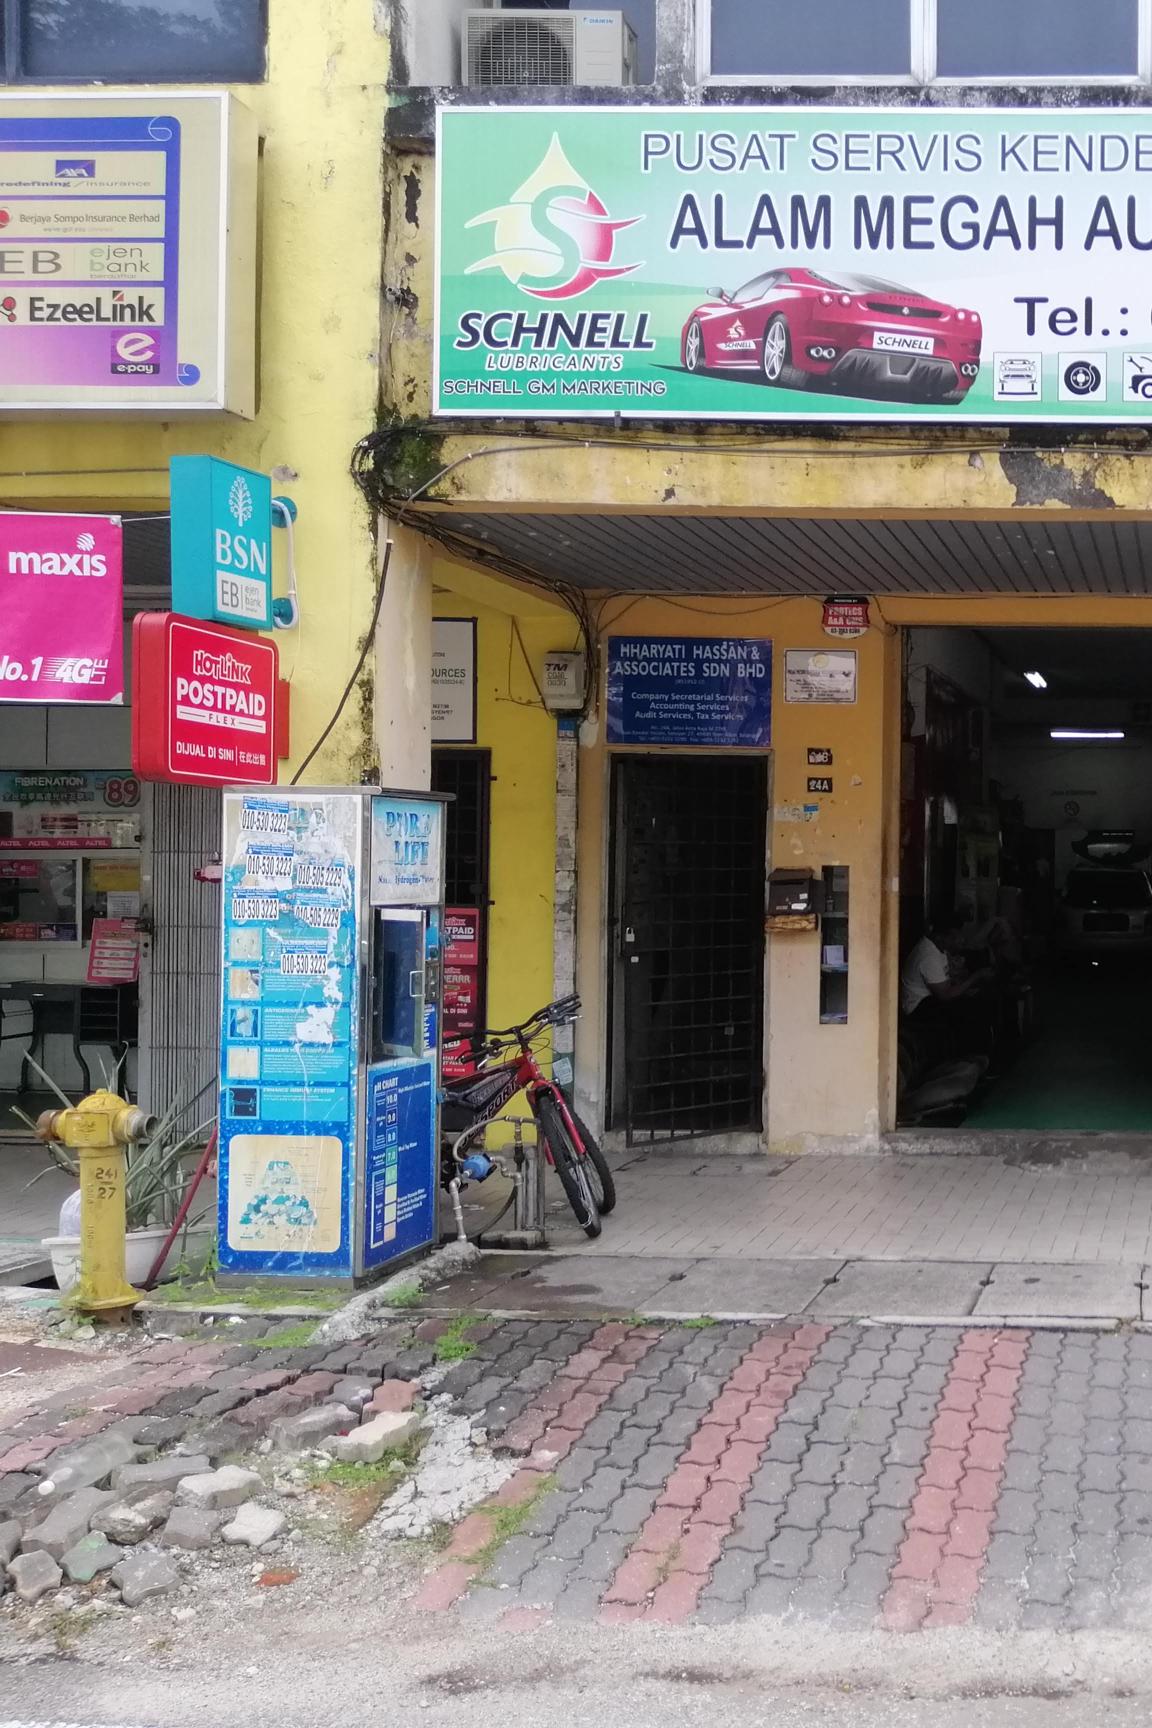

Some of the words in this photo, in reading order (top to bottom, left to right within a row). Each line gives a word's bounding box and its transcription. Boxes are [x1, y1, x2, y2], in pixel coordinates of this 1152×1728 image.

[643, 133, 796, 172] PUSAT
[812, 133, 983, 173] SERVIS
[56, 168, 88, 177] AXA
[20, 213, 52, 225] Berjaya
[54, 213, 84, 224] Sompo
[85, 213, 127, 223] Insurance
[129, 212, 160, 223] Berhad
[669, 193, 832, 251] ALAM
[853, 193, 1065, 252] MEGAH
[90, 245, 143, 260] ejen
[90, 260, 150, 273] bank
[29, 290, 156, 323] EzeeLink
[1013, 296, 1130, 337] Tel.:
[455, 311, 656, 351] SCHNELL
[723, 340, 754, 350] SCHNELL
[877, 335, 931, 351] SCHNELL
[486, 354, 623, 372] LUBRICANTS
[443, 379, 523, 395] SCHNELL
[527, 380, 557, 396] GM
[561, 380, 667, 396] MARKETING
[215, 528, 266, 575] BSN
[9, 550, 107, 577] maxis
[221, 579, 239, 608] EB
[620, 643, 685, 660] HHARYATI
[693, 643, 746, 660] HASSAN
[750, 645, 760, 660] &
[55, 658, 93, 684] 4G
[91, 658, 109, 684] LTE
[545, 663, 568, 671] TM
[613, 660, 695, 677] ASSOCIATES
[702, 662, 729, 677] SDN
[737, 663, 765, 678] BHD
[176, 676, 266, 717] POSTPAID
[631, 691, 669, 702] Company
[670, 692, 713, 701] Secretarial
[715, 692, 748, 702] Services
[634, 711, 656, 719] Audit
[658, 711, 693, 720] Services,
[696, 712, 709, 720] Tax
[711, 712, 744, 721] Services
[649, 702, 694, 712] Accounting
[696, 702, 729, 711] Services
[208, 712, 237, 727] FLEX
[176, 740, 206, 757] DIJUAL
[207, 745, 216, 759] DI
[218, 747, 234, 761] SINI
[15, 777, 84, 787] FIBRENATION
[104, 775, 141, 807] 89
[809, 779, 829, 790] 24A
[242, 809, 269, 831] 010-530
[269, 812, 287, 833] 3223
[247, 855, 274, 875] 010-530
[275, 857, 292, 876] 3223
[297, 865, 324, 886] 010-505
[324, 867, 342, 887] 2229
[233, 899, 259, 918] 010-530
[260, 899, 278, 918] 3223
[322, 908, 339, 928] 2229
[282, 954, 308, 974] 010-530
[309, 954, 326, 974] 3223
[382, 1077, 399, 1090] CHART
[98, 1186, 117, 1200] 27
